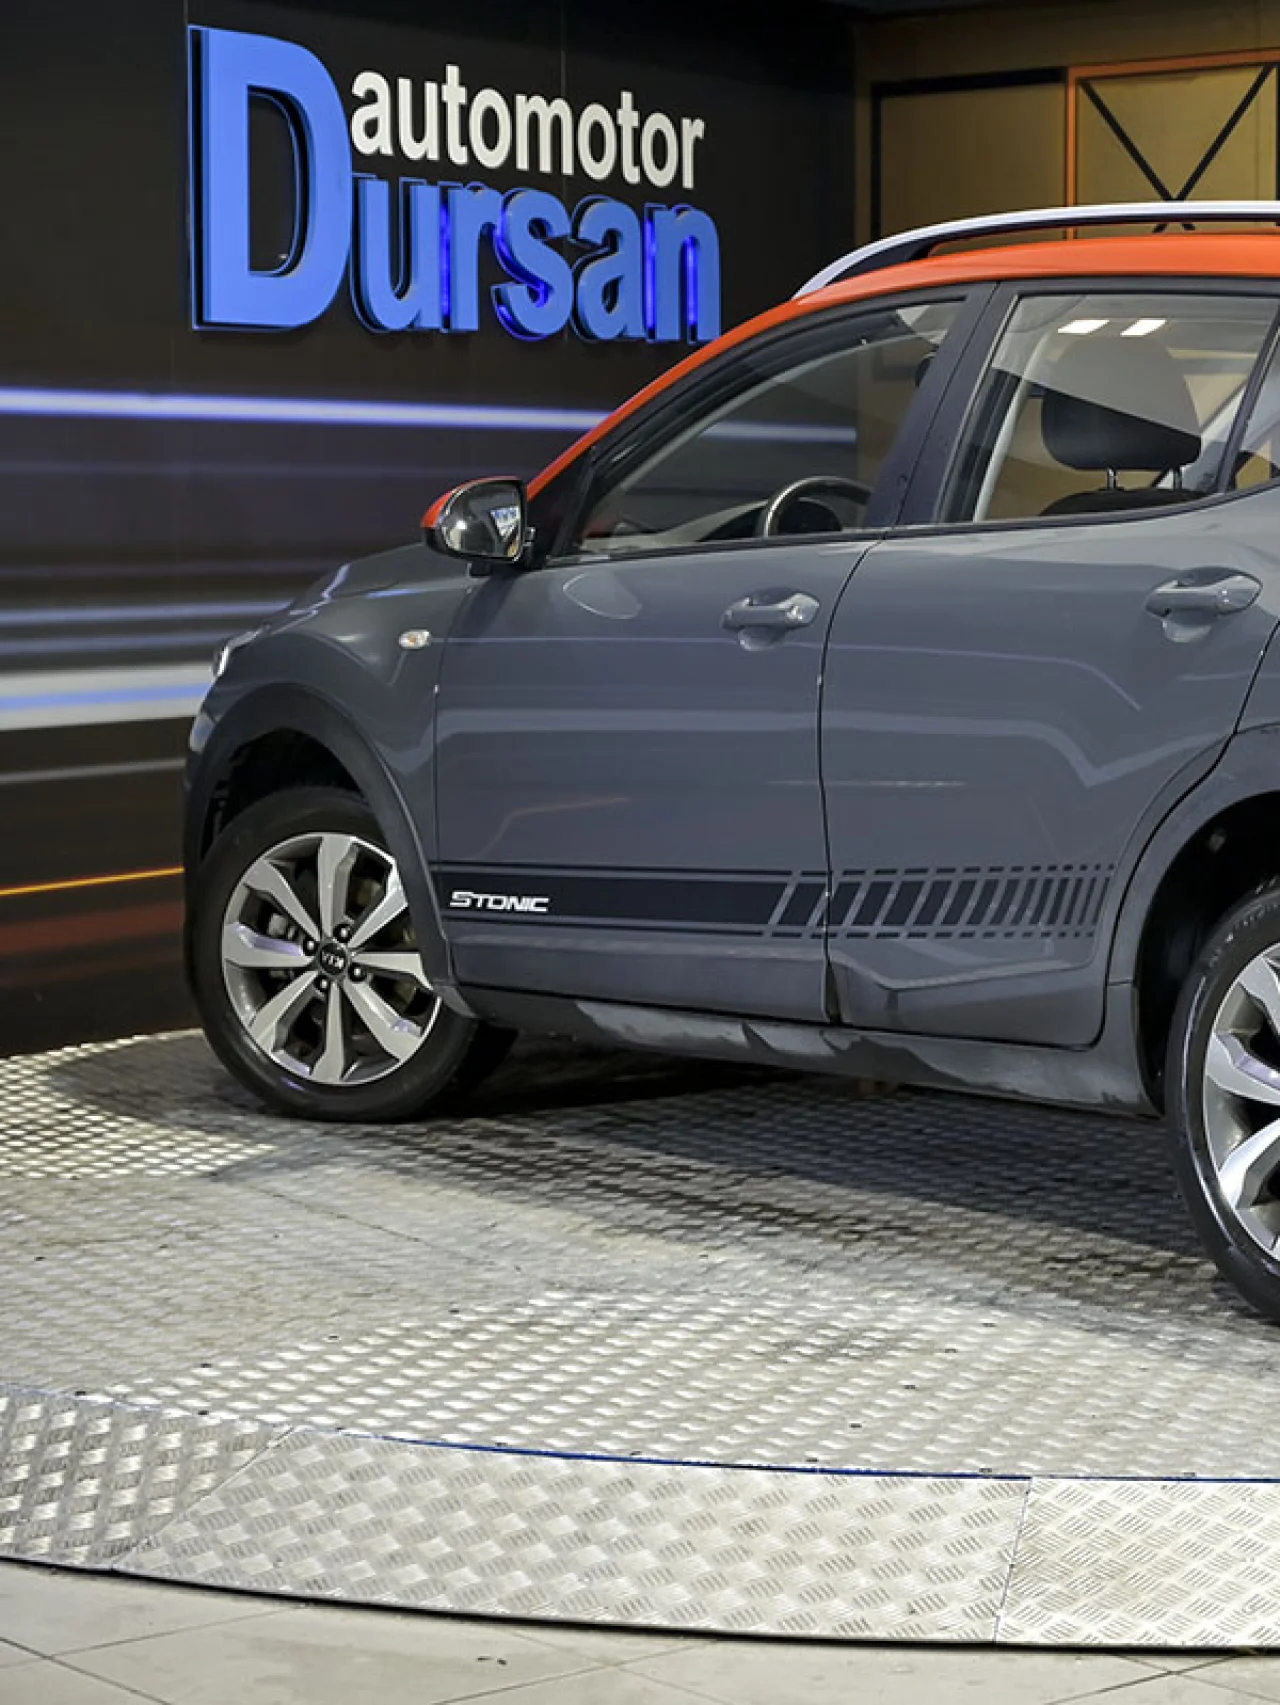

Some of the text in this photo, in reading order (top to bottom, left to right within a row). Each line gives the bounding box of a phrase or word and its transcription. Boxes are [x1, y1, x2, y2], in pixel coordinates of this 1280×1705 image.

[187, 24, 721, 344] Dursan
[351, 64, 704, 189] automotor
[449, 891, 549, 912] STONIC
